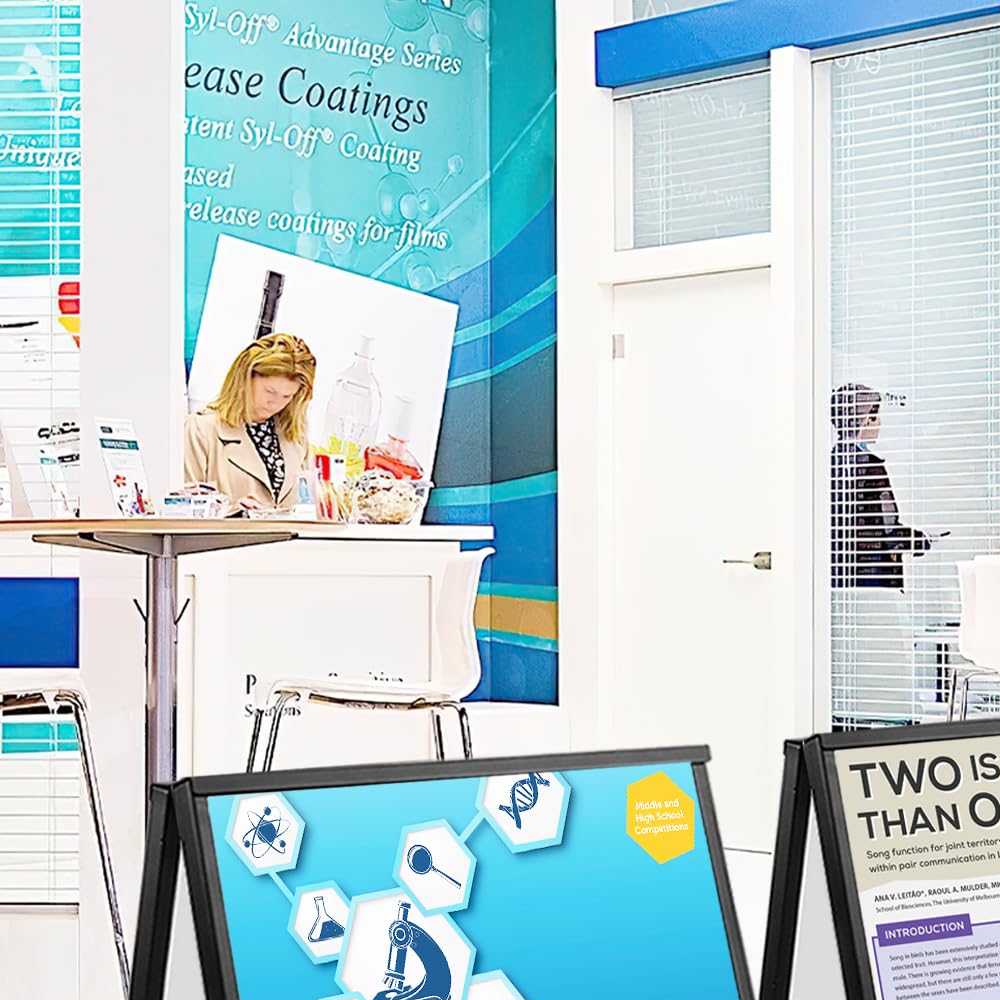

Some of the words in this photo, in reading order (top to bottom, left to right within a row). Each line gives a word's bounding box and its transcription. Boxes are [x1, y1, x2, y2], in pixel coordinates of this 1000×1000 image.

[283, 22, 396, 67] Advantage
[401, 42, 462, 75] Series
[278, 66, 429, 132] Coatings
[340, 133, 422, 173] Coating
[267, 210, 357, 243] coatings
[359, 216, 394, 246] for
[394, 221, 450, 250] films
[848, 755, 962, 799] TWO
[969, 752, 1000, 781] IS
[635, 800, 663, 811] Middle
[663, 798, 680, 809] and
[635, 812, 656, 825] High
[655, 810, 684, 821] School
[634, 823, 689, 835] Competitions
[856, 803, 961, 839] THAN
[866, 850, 891, 861] Song
[891, 846, 930, 857] function
[930, 843, 944, 852] for
[945, 841, 966, 853] joint
[868, 862, 898, 873] within
[898, 860, 918, 872] pair
[918, 853, 987, 868] communication
[987, 851, 997, 860] in
[884, 920, 965, 940] INTRODUCTION
